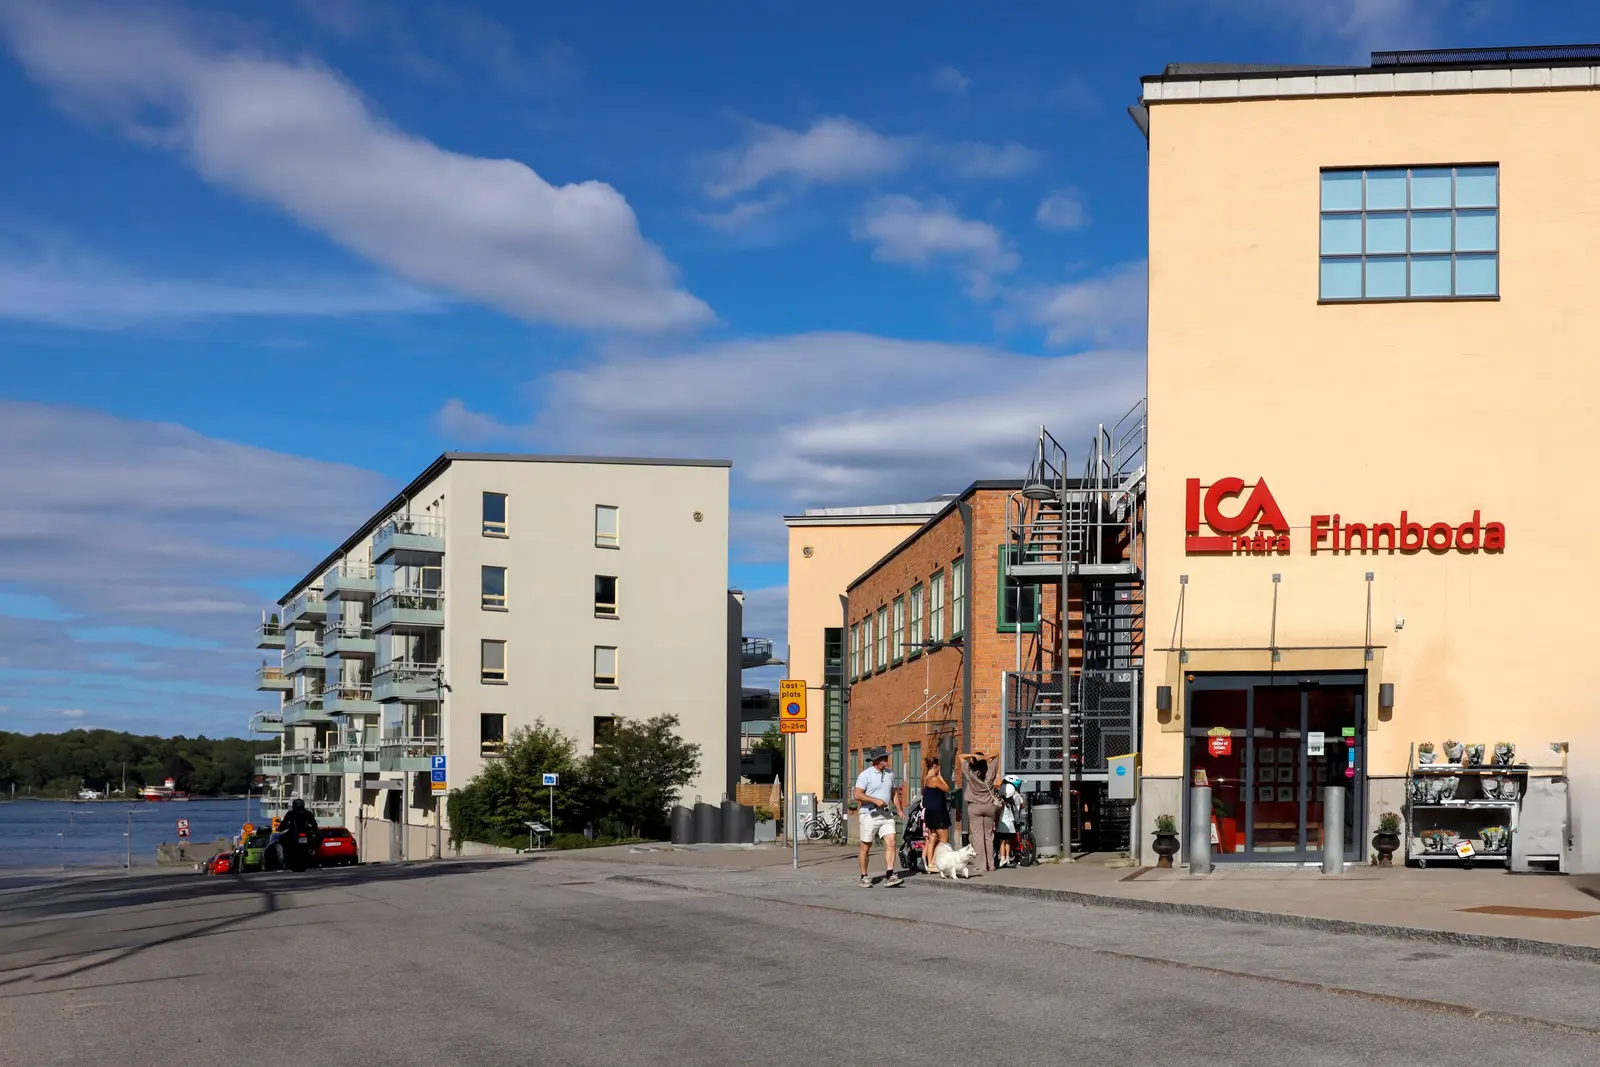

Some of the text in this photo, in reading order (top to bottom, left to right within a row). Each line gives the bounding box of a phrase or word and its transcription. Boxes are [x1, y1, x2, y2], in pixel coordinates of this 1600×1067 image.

[1186, 476, 1290, 532] ICA
[1236, 531, 1290, 552] nära
[1310, 510, 1506, 551] Finnboda
[435, 757, 444, 768] P
